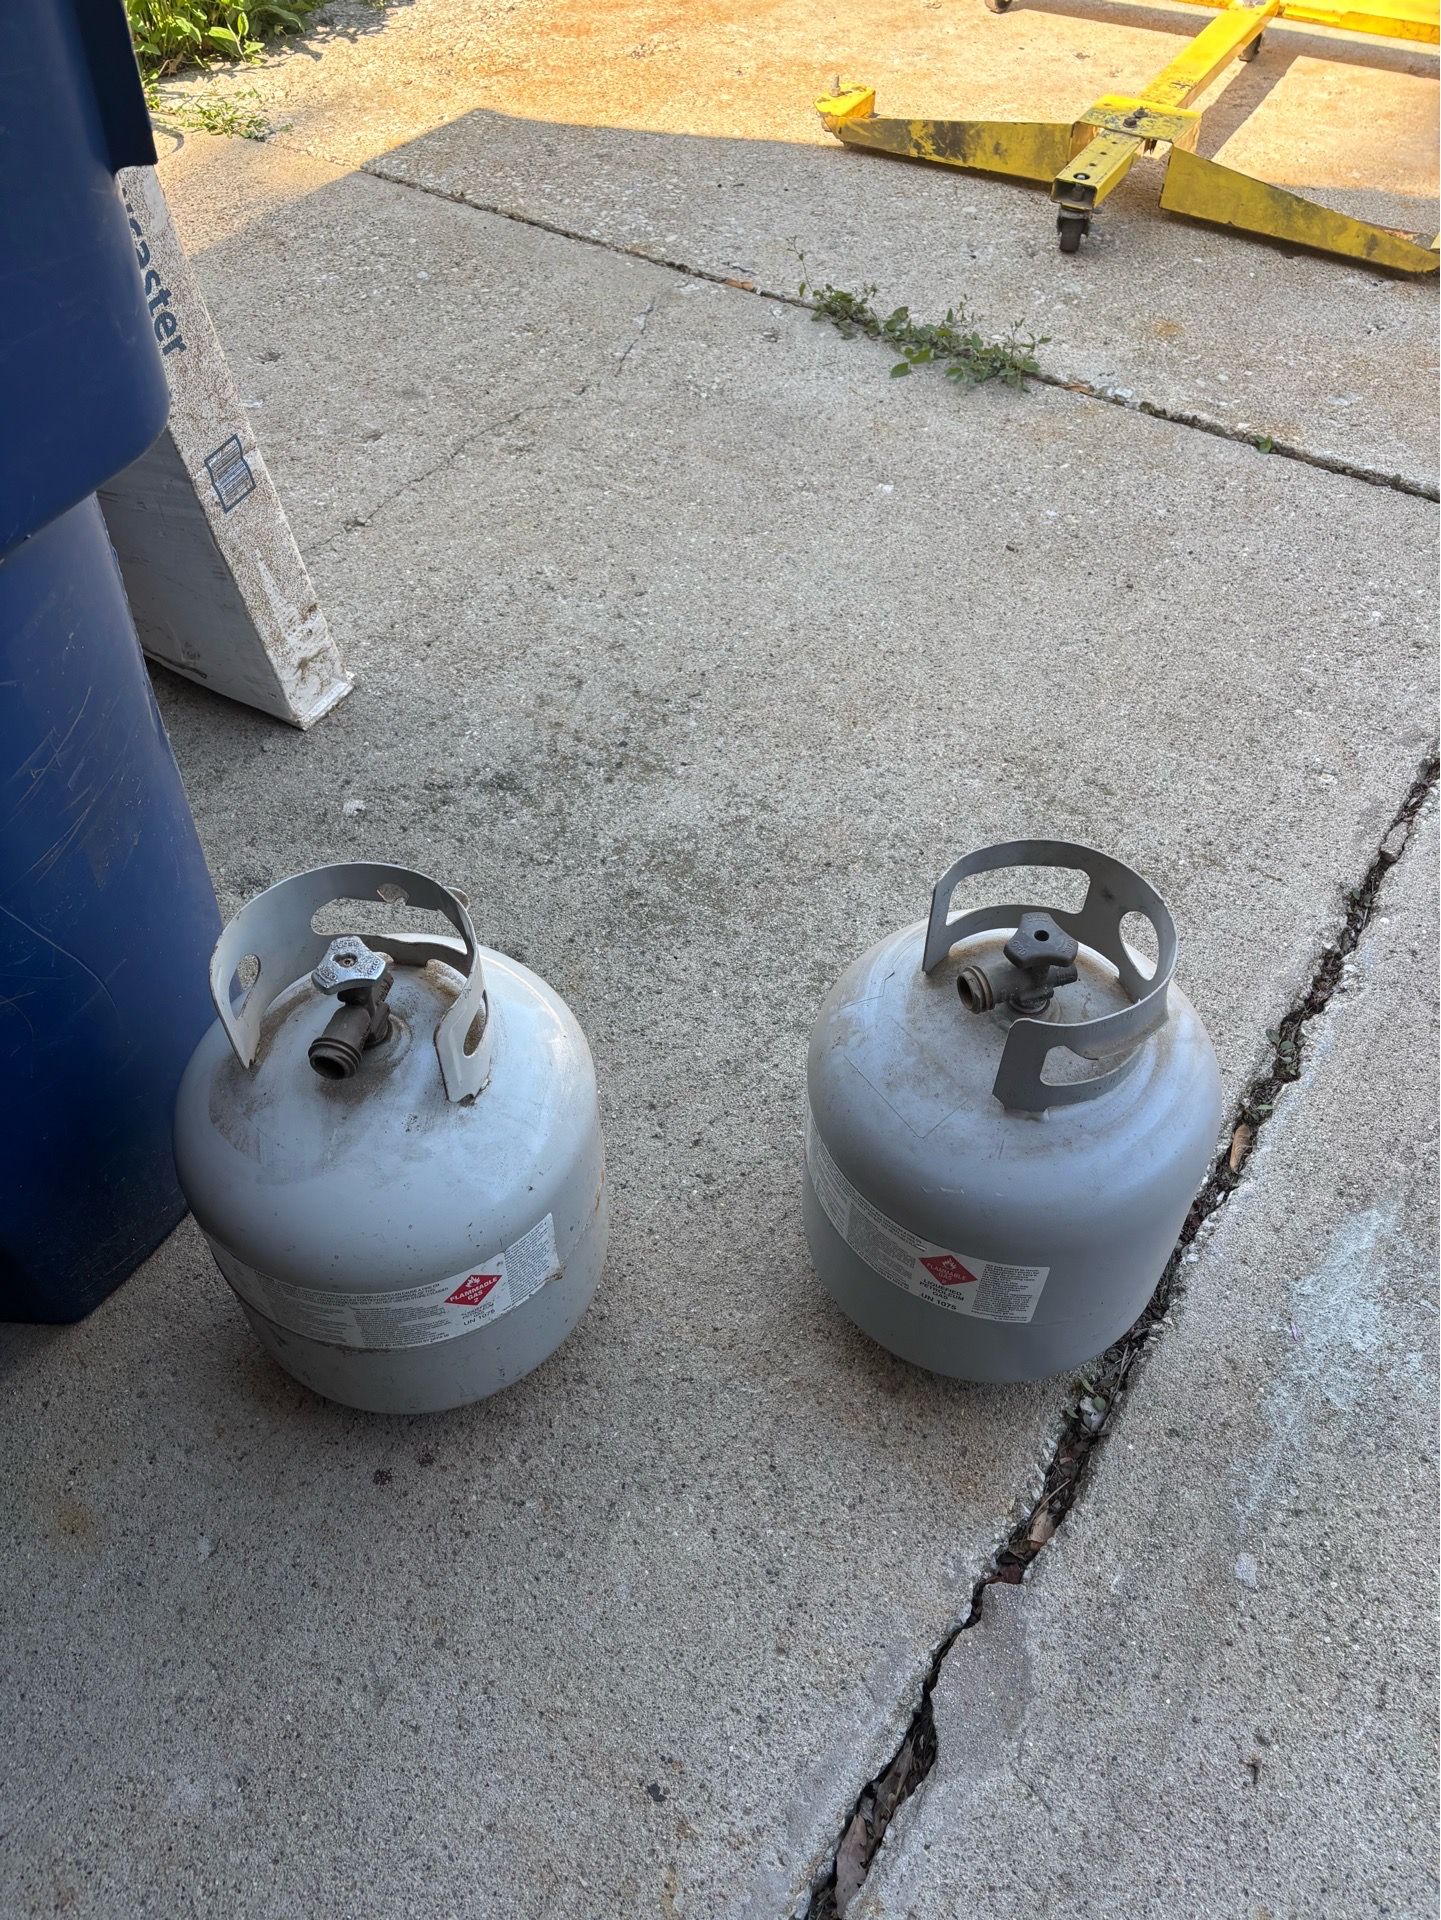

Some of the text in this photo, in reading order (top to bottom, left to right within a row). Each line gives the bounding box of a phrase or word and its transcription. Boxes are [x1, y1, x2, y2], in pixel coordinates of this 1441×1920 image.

[925, 1262, 969, 1281] FLAMMABLE
[938, 1272, 953, 1281] GAS
[449, 1276, 499, 1303] FLAMMABLE
[467, 1290, 483, 1301] GAS
[919, 1281, 965, 1302] PETROLEUM
[932, 1291, 949, 1301] GAS
[921, 1292, 957, 1311] UN 1075
[463, 1317, 476, 1326] UN
